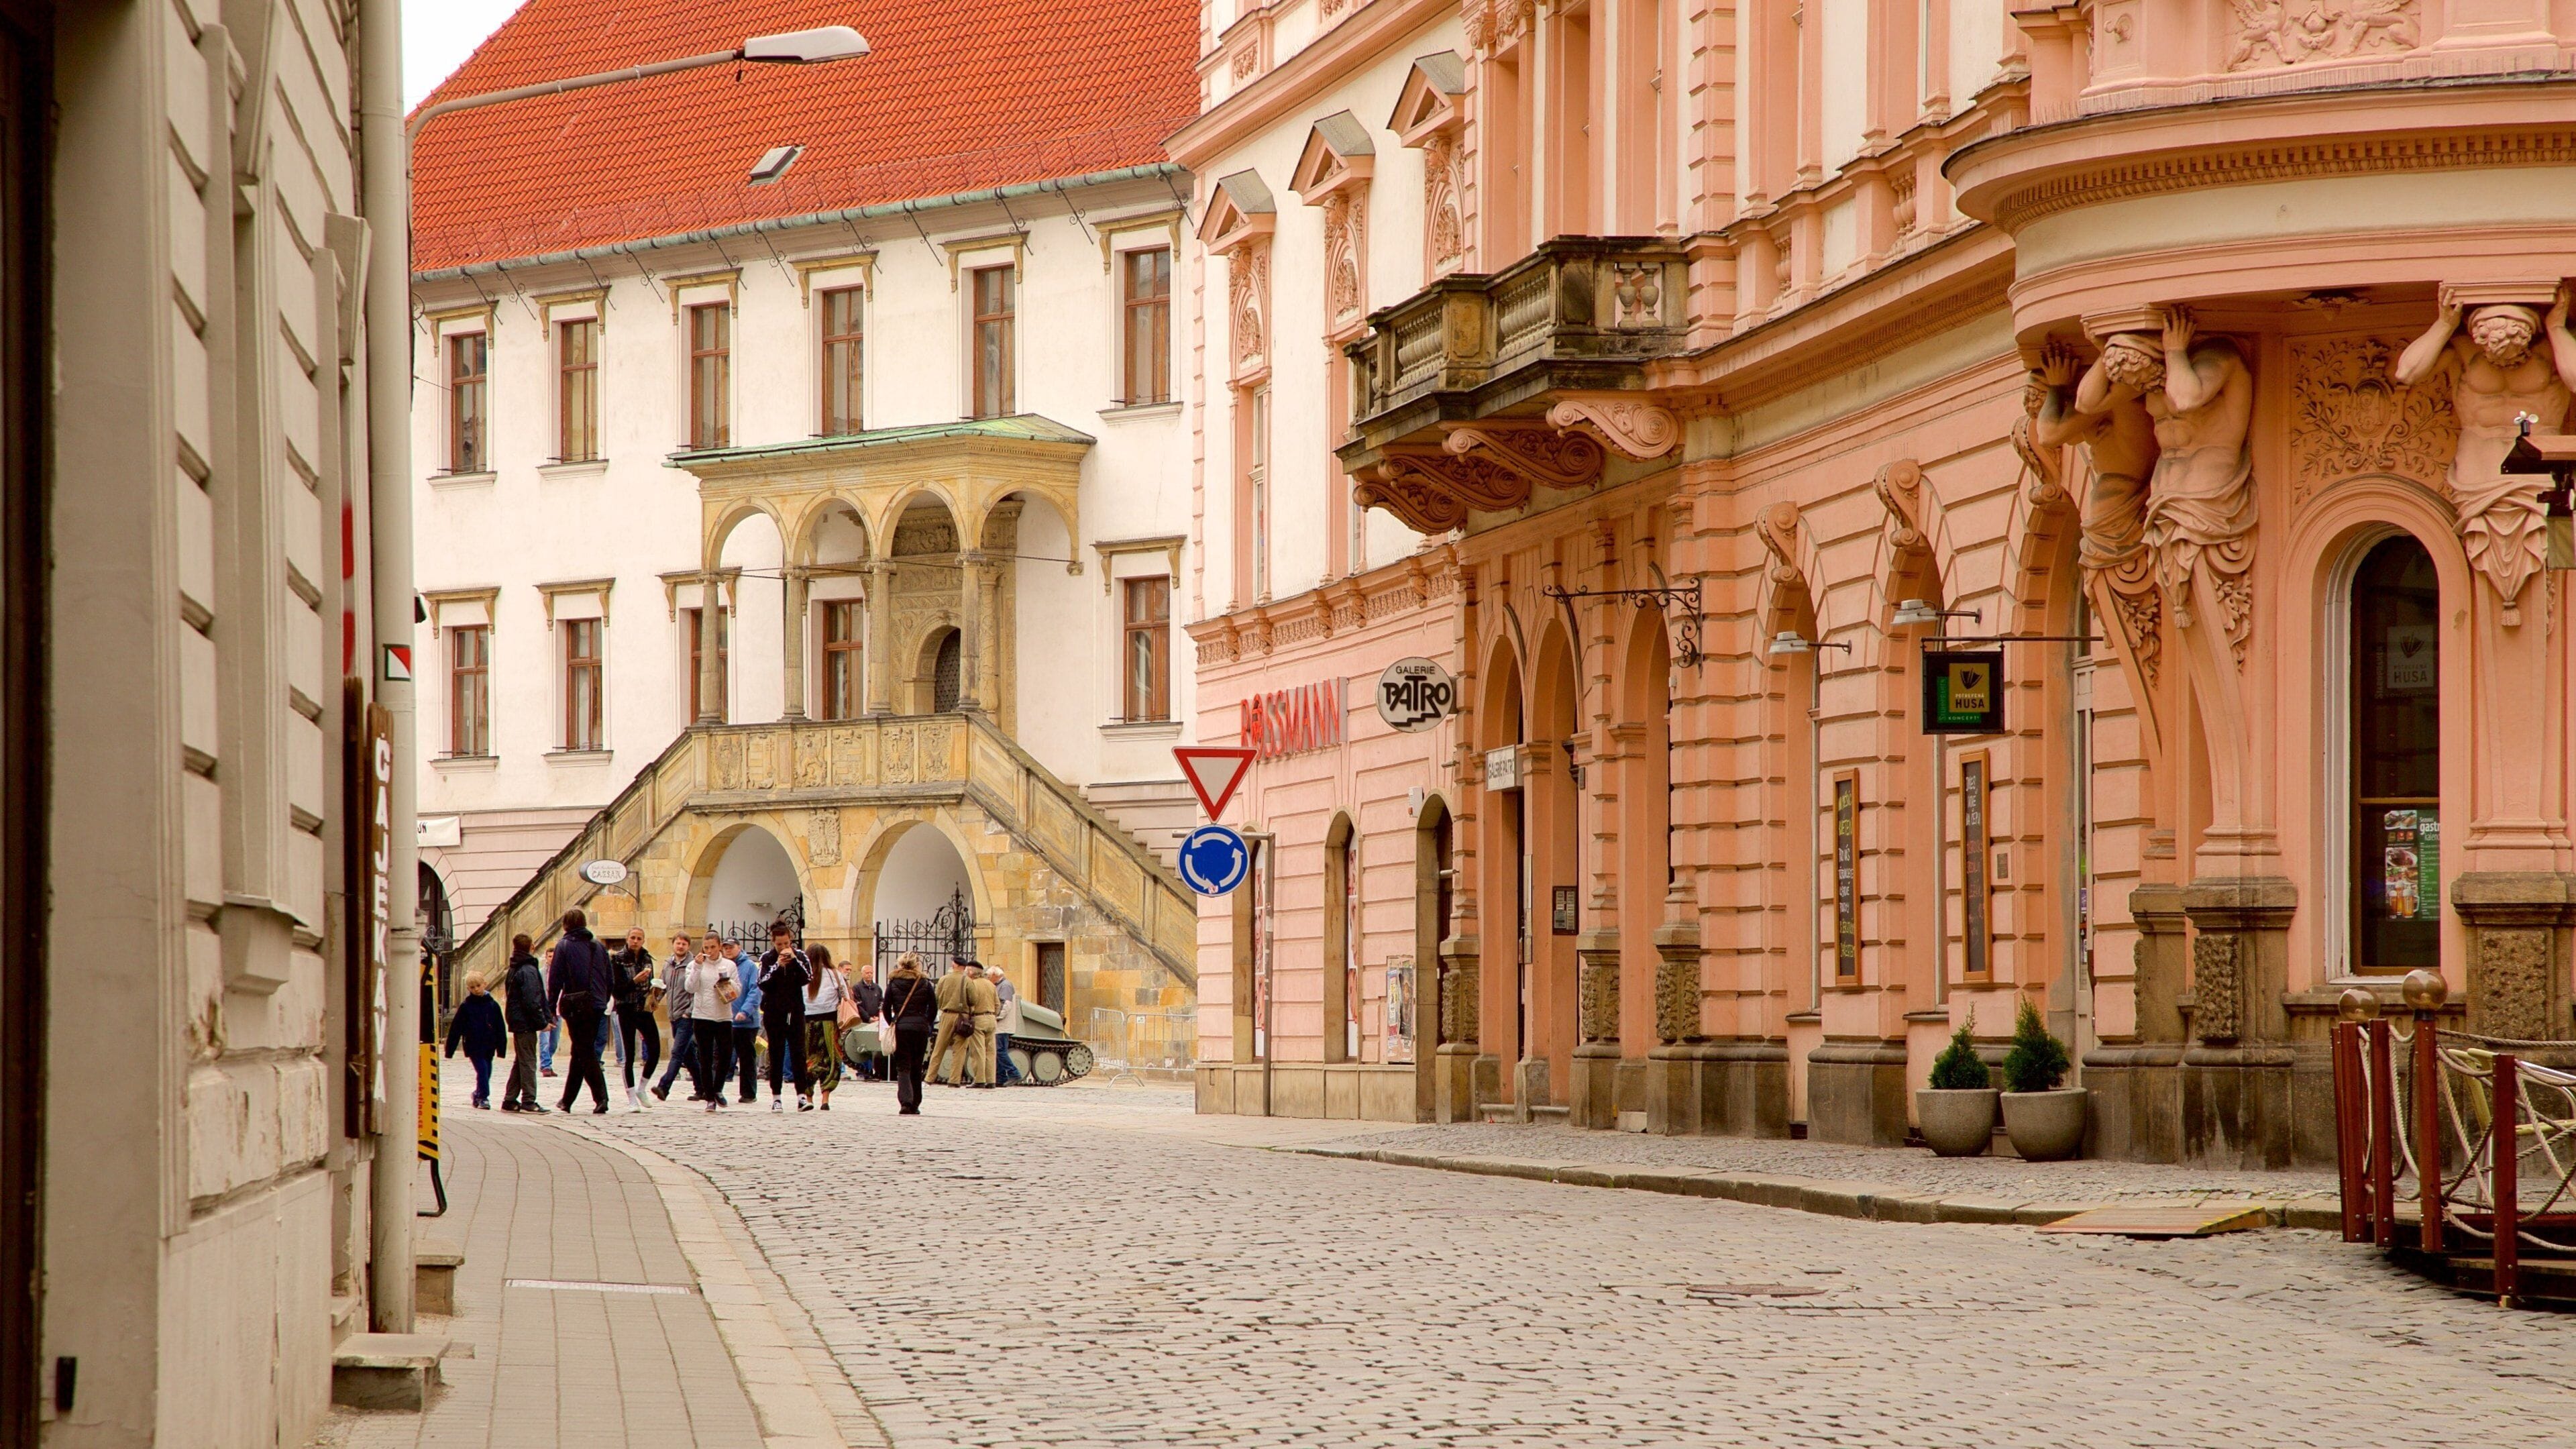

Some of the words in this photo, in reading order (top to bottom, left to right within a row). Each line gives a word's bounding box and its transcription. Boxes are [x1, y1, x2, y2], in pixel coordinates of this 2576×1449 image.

[1395, 665, 1436, 675] GALERIE
[2394, 670, 2427, 683] HUSA
[1382, 676, 1451, 716] PATRO
[1955, 699, 1985, 708] HUSA
[1240, 676, 1347, 761] ROSSMANN
